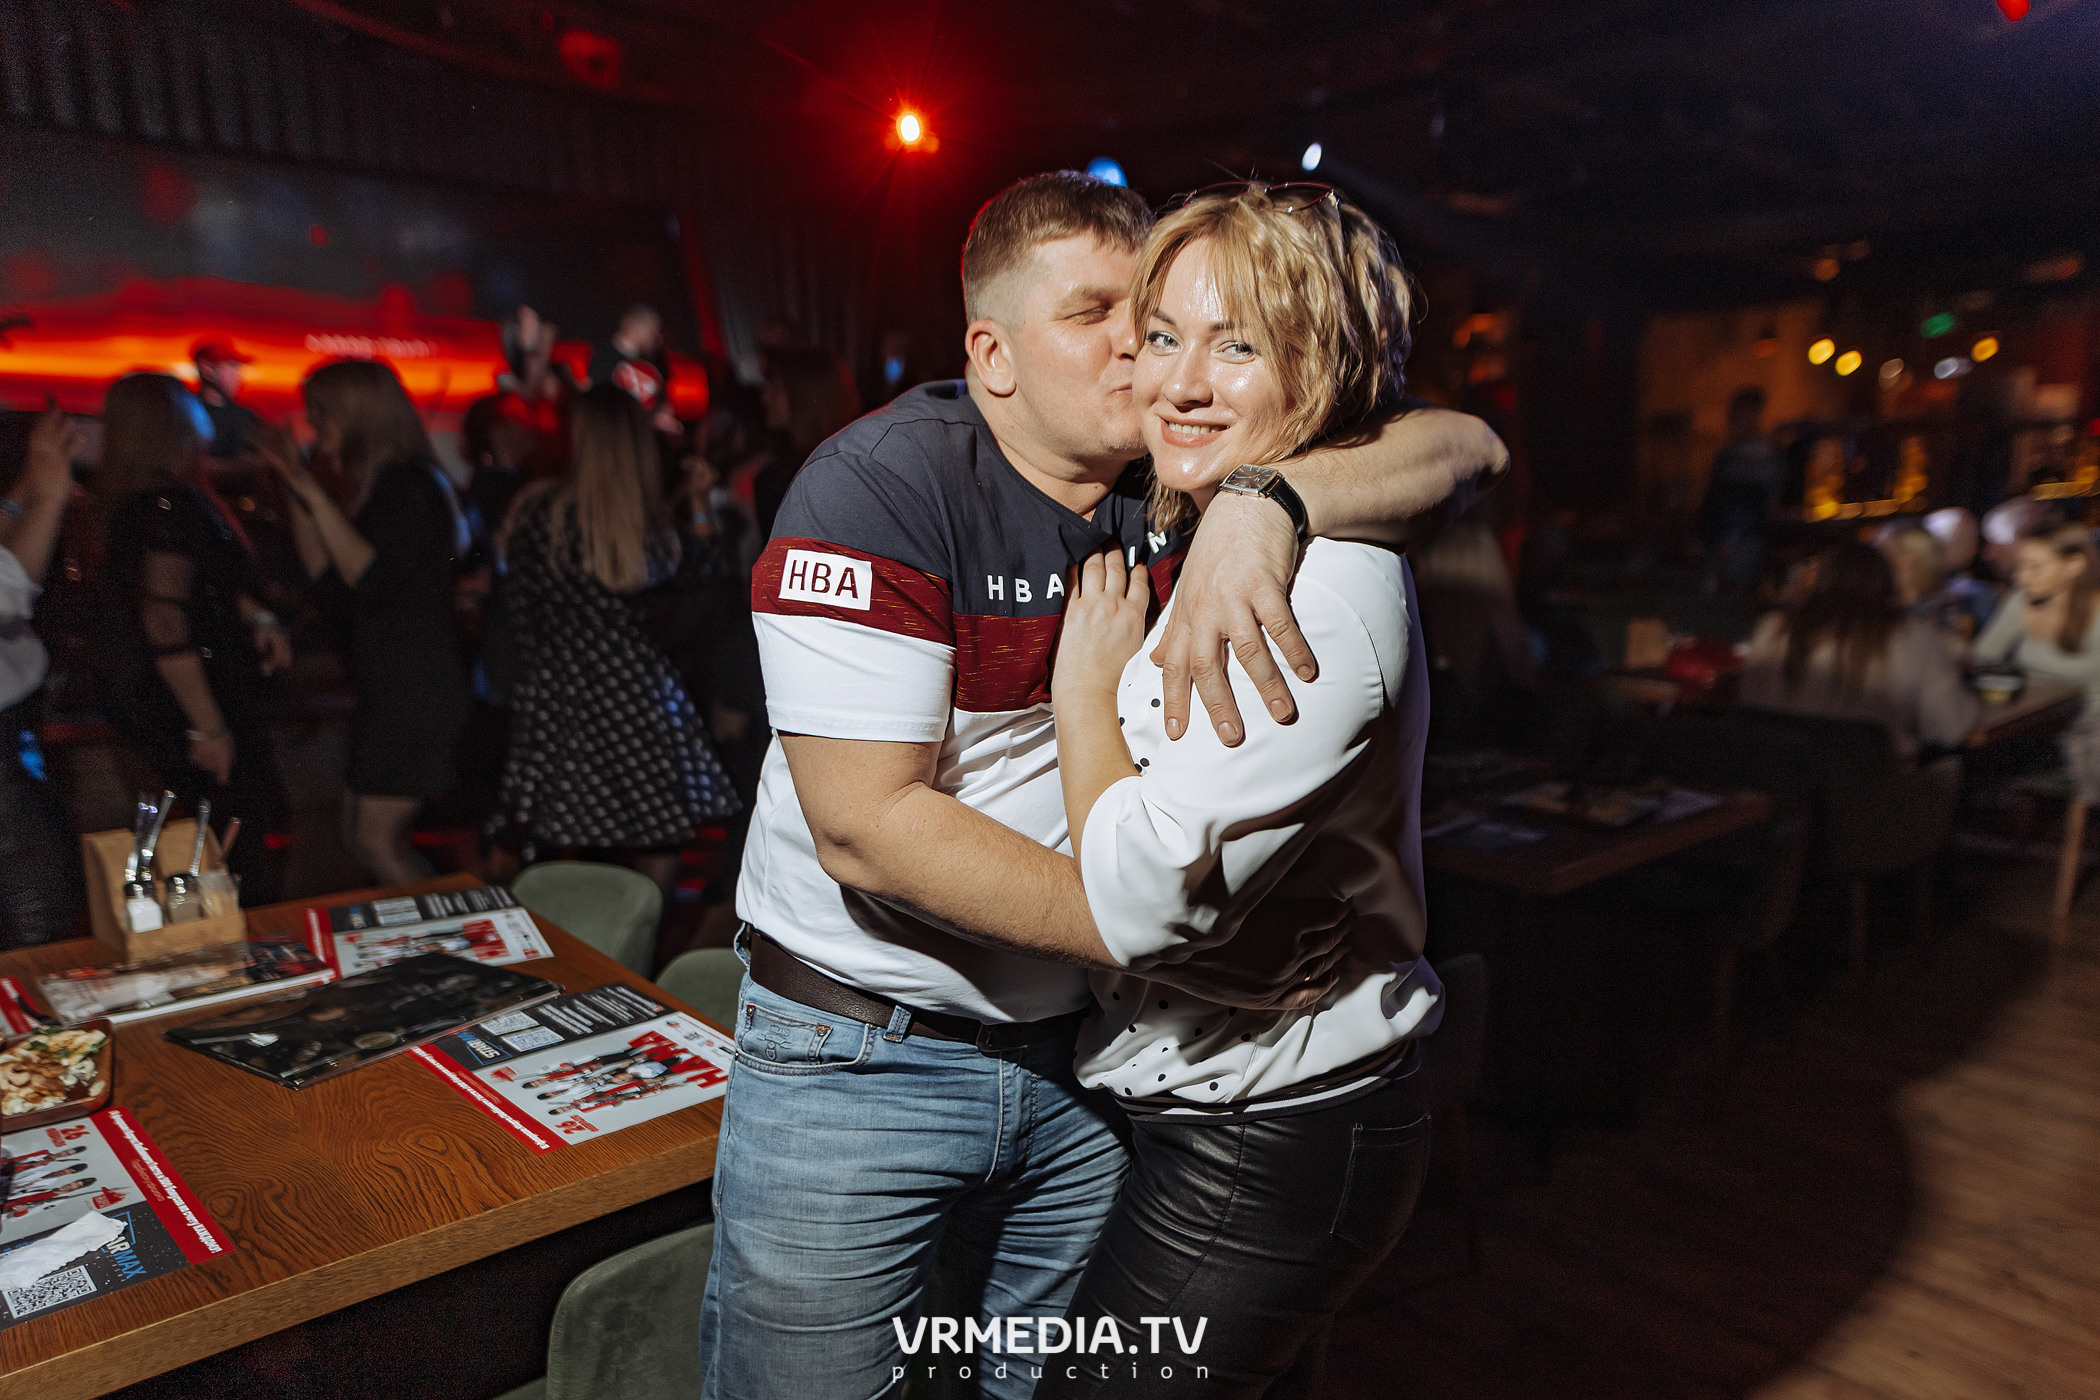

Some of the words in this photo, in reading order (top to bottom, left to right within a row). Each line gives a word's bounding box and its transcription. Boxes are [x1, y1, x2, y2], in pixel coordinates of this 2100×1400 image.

[788, 559, 859, 600] HBA
[60, 1124, 91, 1141] 26
[555, 1120, 586, 1135] 26
[106, 1236, 148, 1280] ARMAX
